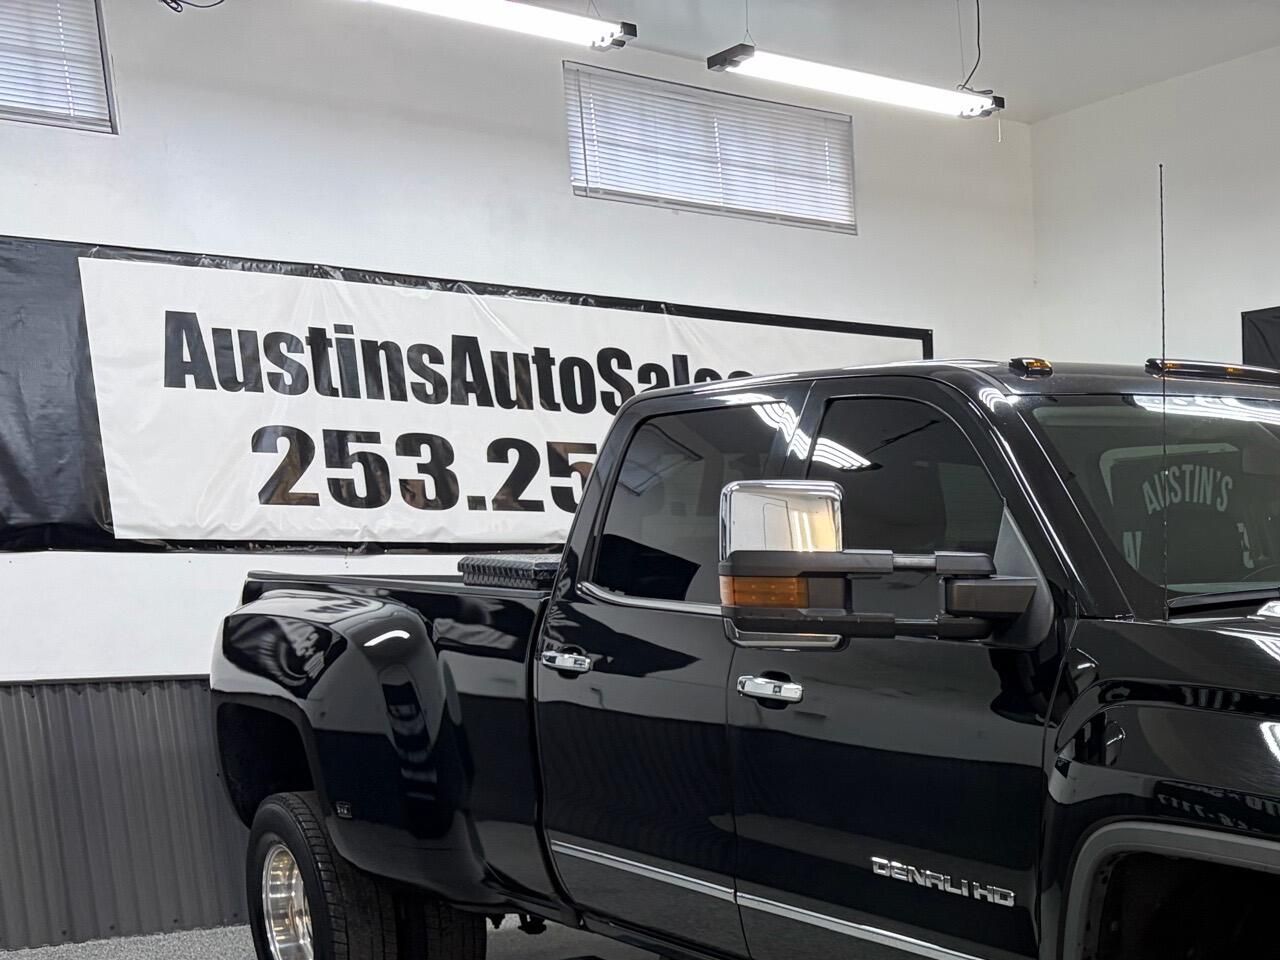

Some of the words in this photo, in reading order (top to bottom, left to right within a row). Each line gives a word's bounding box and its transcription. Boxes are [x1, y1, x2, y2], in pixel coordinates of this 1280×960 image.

[163, 310, 754, 416] AustinsAutoS
[250, 425, 598, 514] 253.25
[1142, 464, 1233, 515] AUSTIN'S
[871, 856, 969, 897] DENALI
[973, 881, 1016, 907] HD
